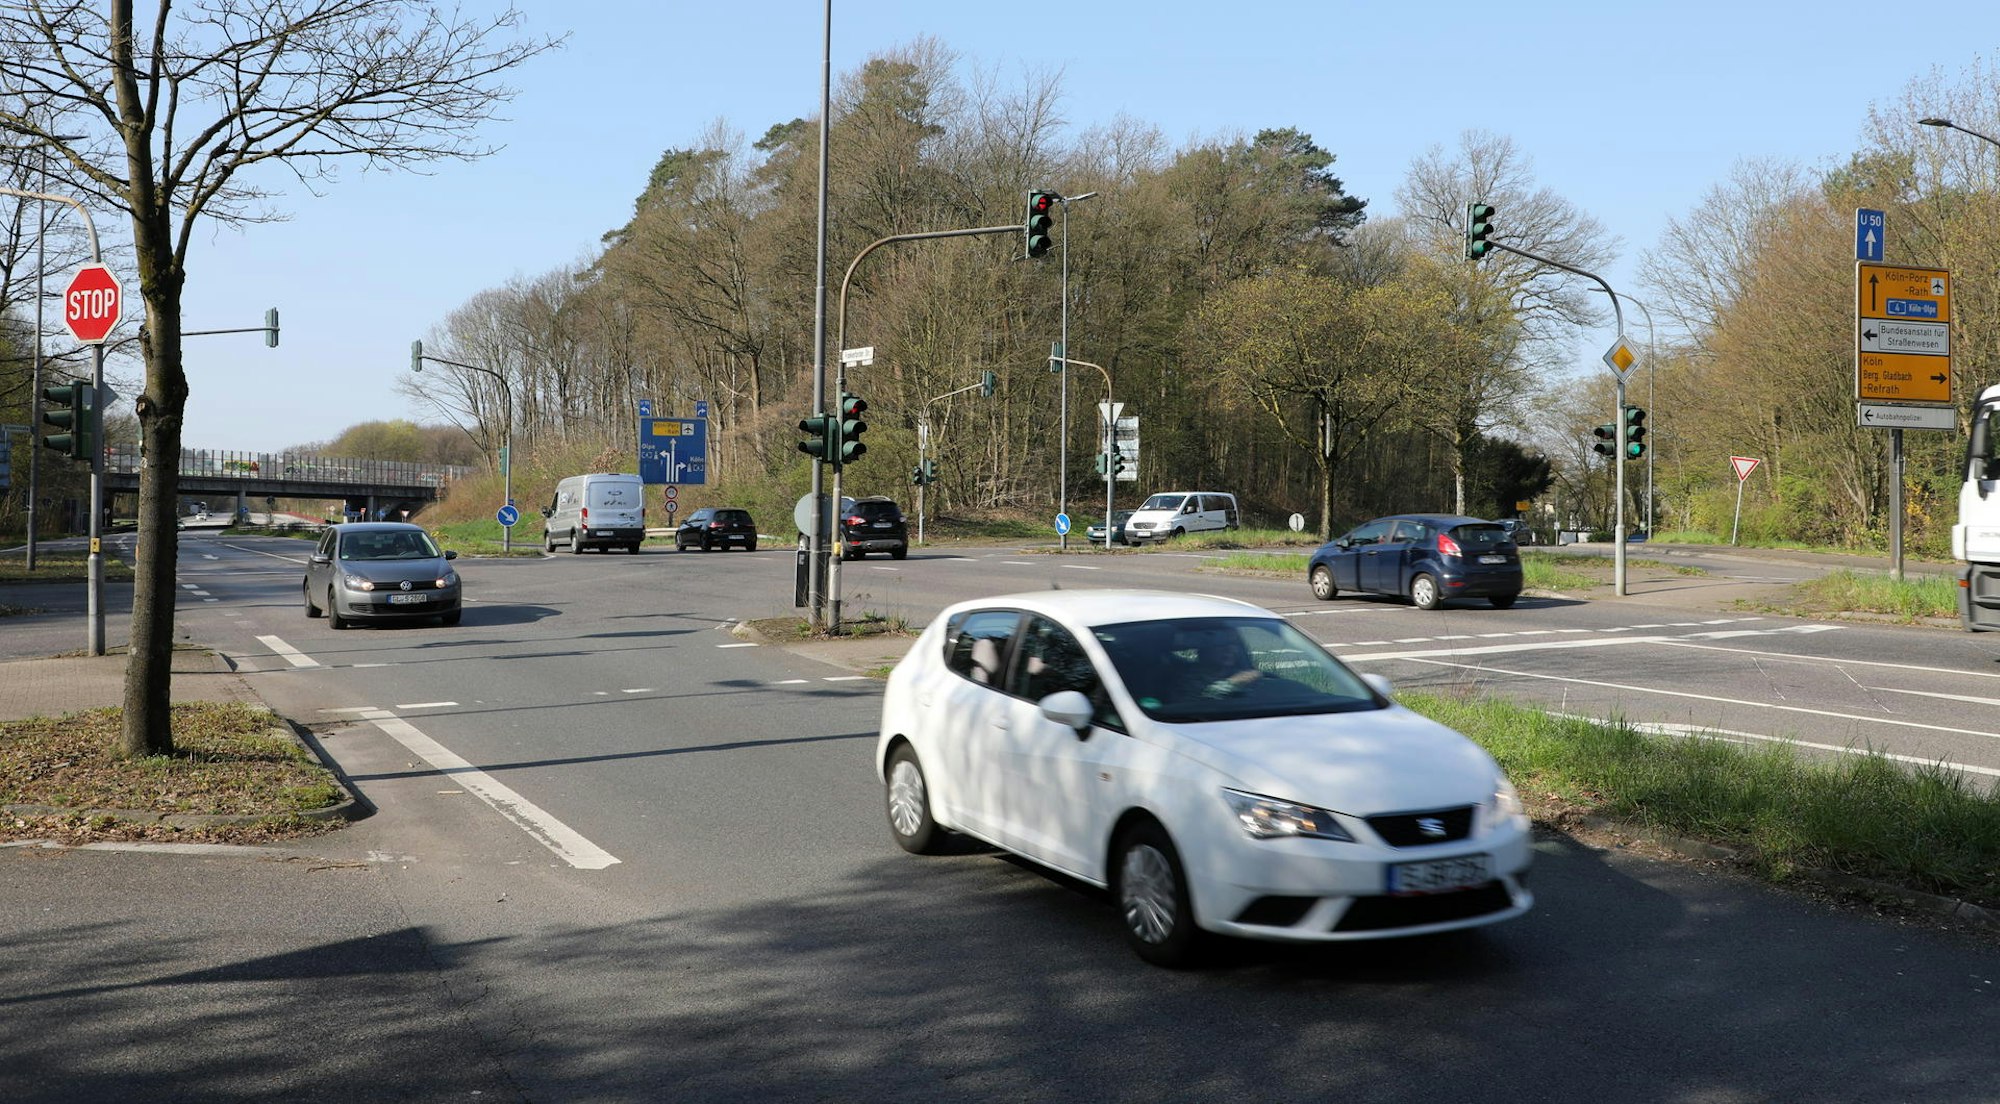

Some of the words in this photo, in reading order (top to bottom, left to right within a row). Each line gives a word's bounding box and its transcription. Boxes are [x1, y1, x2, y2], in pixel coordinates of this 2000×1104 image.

[1860, 214, 1867, 225] U
[1869, 215, 1881, 227] 50
[1885, 271, 1928, 283] Köln-Porz
[1905, 286, 1929, 297] -Rath
[69, 288, 116, 321] STOP
[1881, 325, 1932, 337] Bundesanstalt
[1934, 328, 1945, 338] für
[1887, 337, 1939, 348] Straßenwesen
[1863, 356, 1883, 366] Köln
[1882, 371, 1912, 381] Gladbach
[1864, 383, 1900, 394] -Refrath
[1876, 412, 1922, 422] Autobahnpolizei
